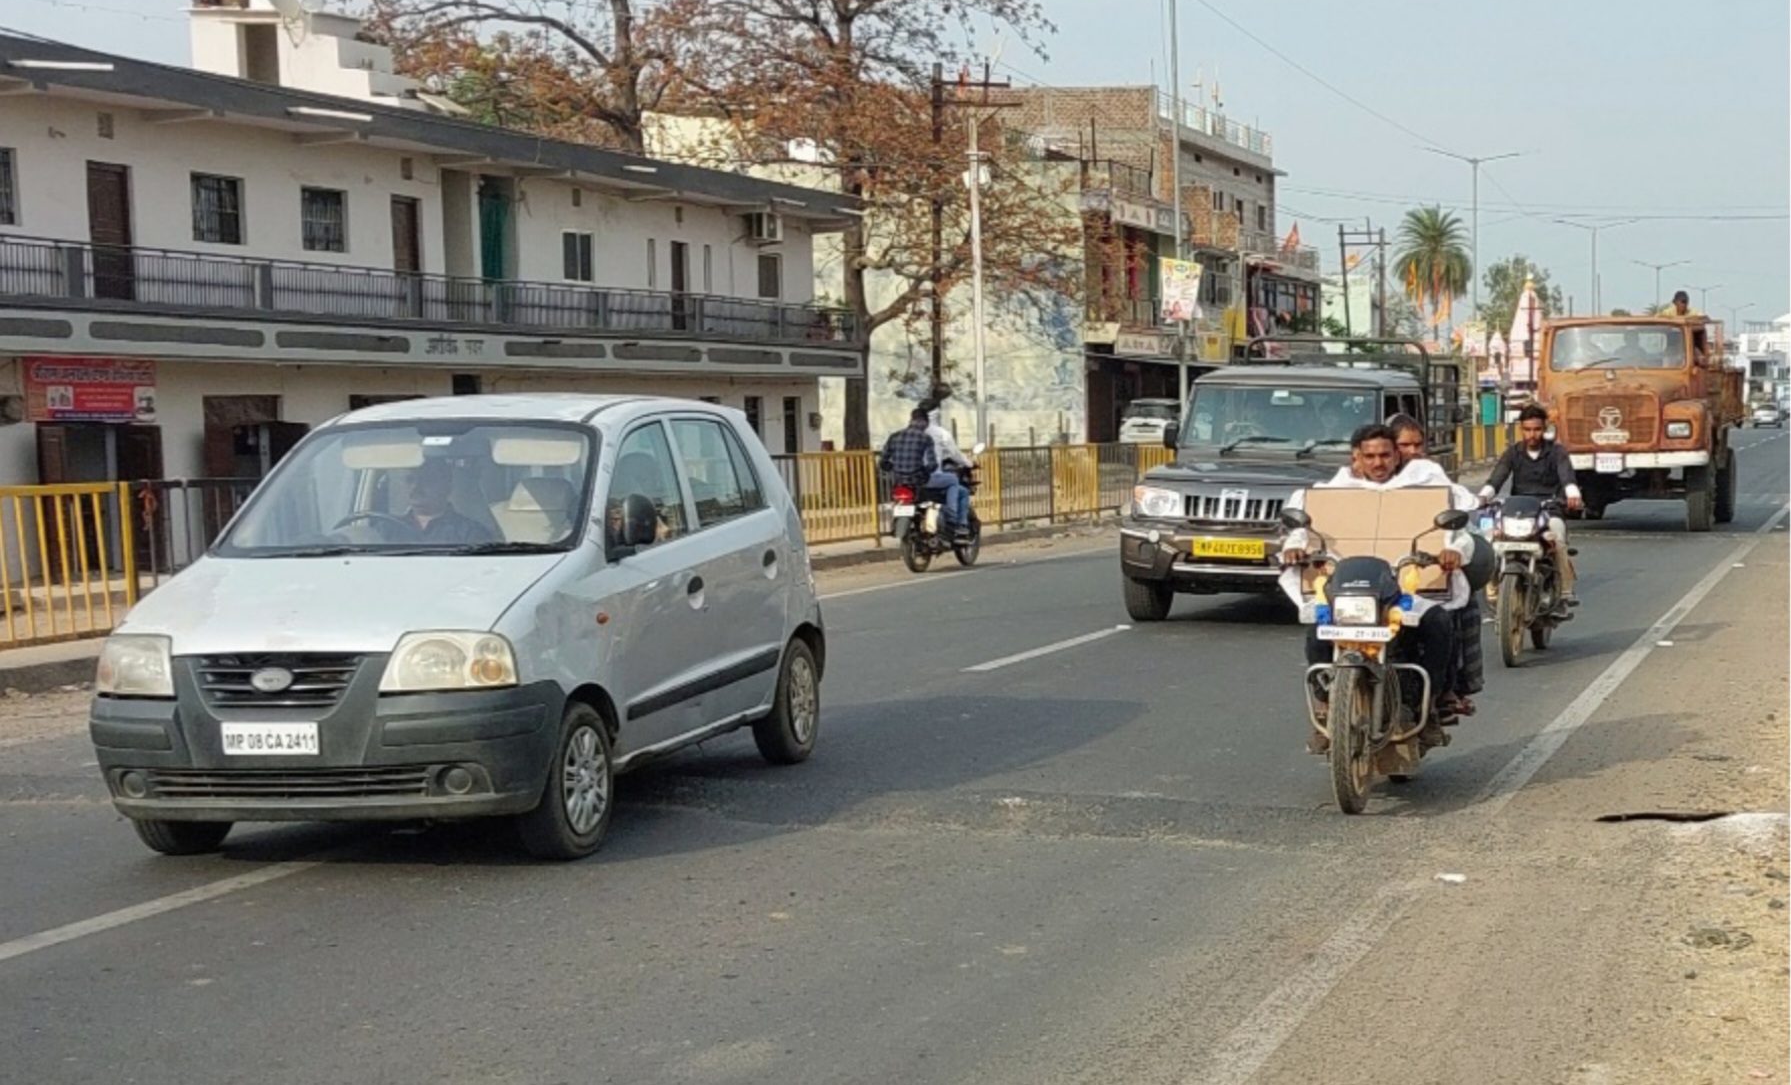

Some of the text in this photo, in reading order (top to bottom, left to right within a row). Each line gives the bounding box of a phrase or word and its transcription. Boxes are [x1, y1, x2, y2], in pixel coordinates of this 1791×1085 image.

[225, 734, 244, 750] MP
[265, 733, 284, 749] CA
[285, 733, 316, 750] 2411
